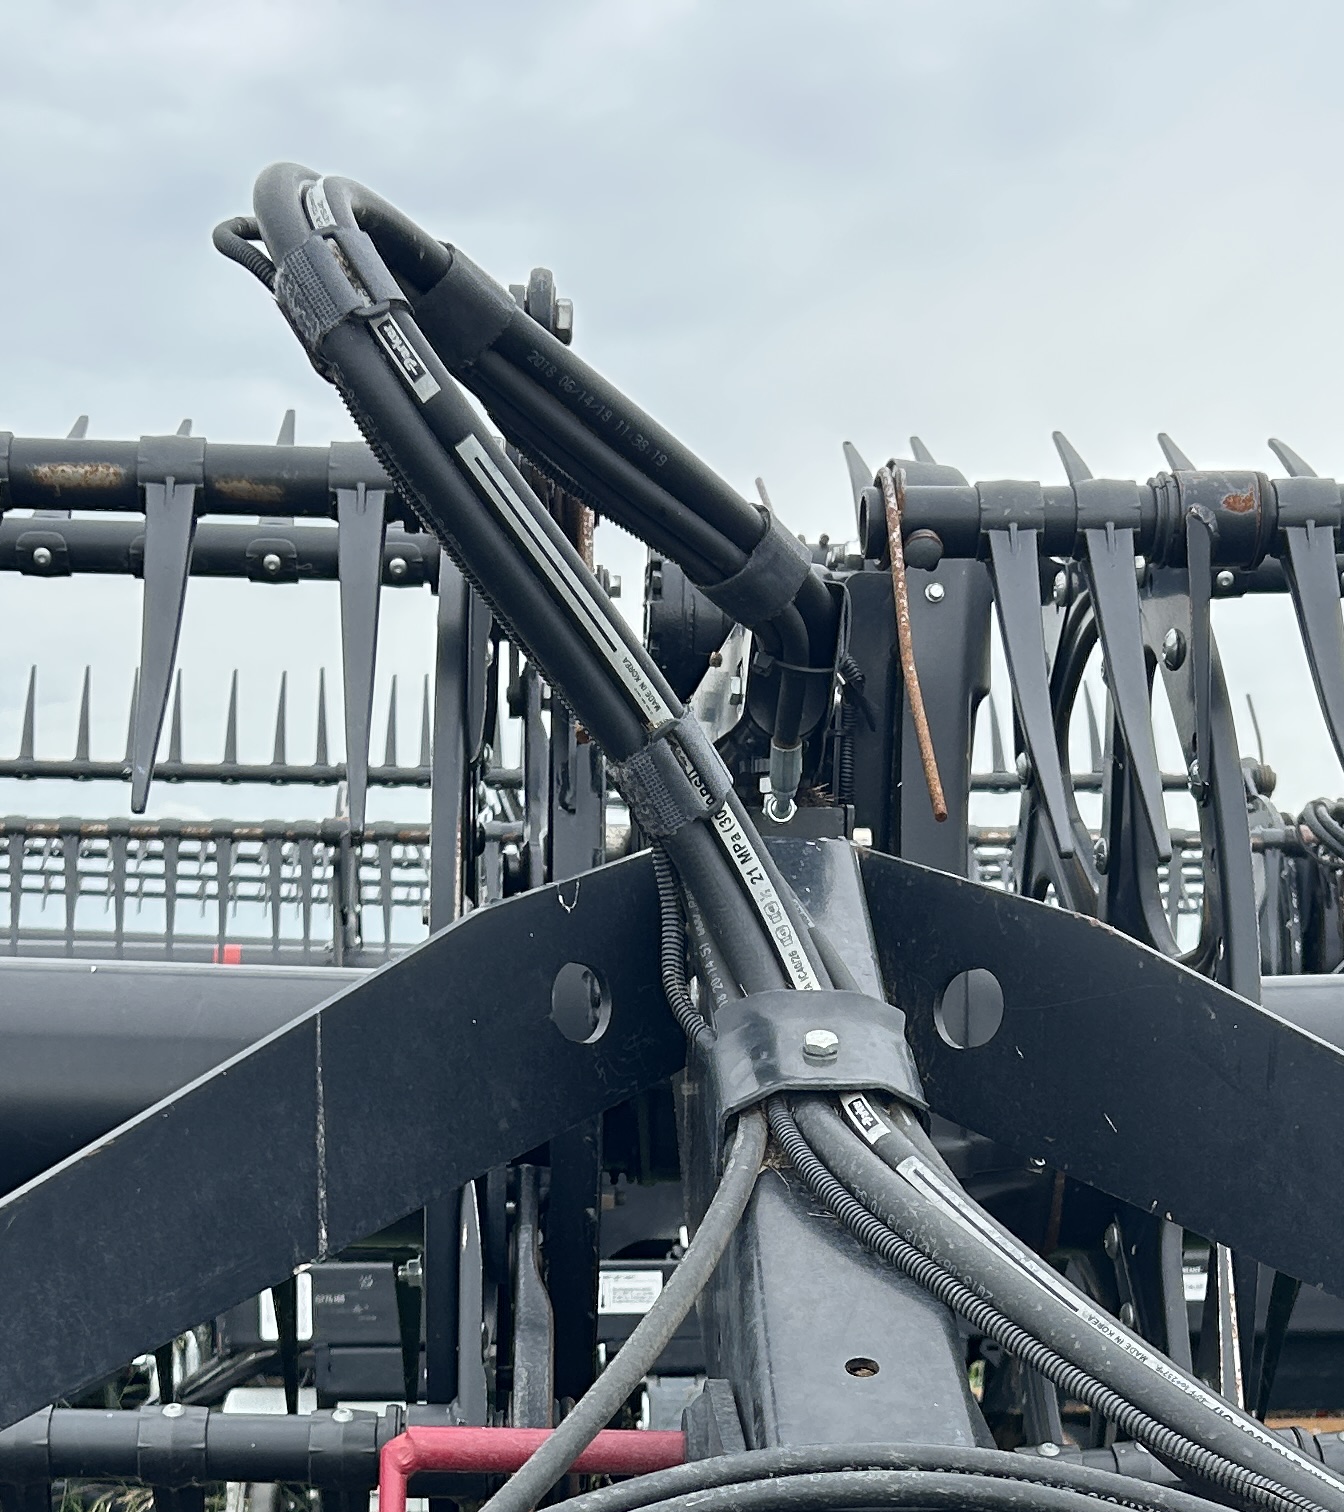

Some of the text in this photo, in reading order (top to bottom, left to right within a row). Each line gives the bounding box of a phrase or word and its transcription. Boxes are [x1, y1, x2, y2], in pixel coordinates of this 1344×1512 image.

[379, 320, 423, 378] Parker
[620, 655, 642, 683] KOREA
[637, 680, 648, 692] IN
[643, 689, 662, 712] MADE
[726, 830, 753, 866] MPa
[745, 864, 764, 886] 21
[1085, 1312, 1116, 1338] KOREA
[1112, 1333, 1125, 1346] IN
[1121, 1340, 1149, 1364] MADE
